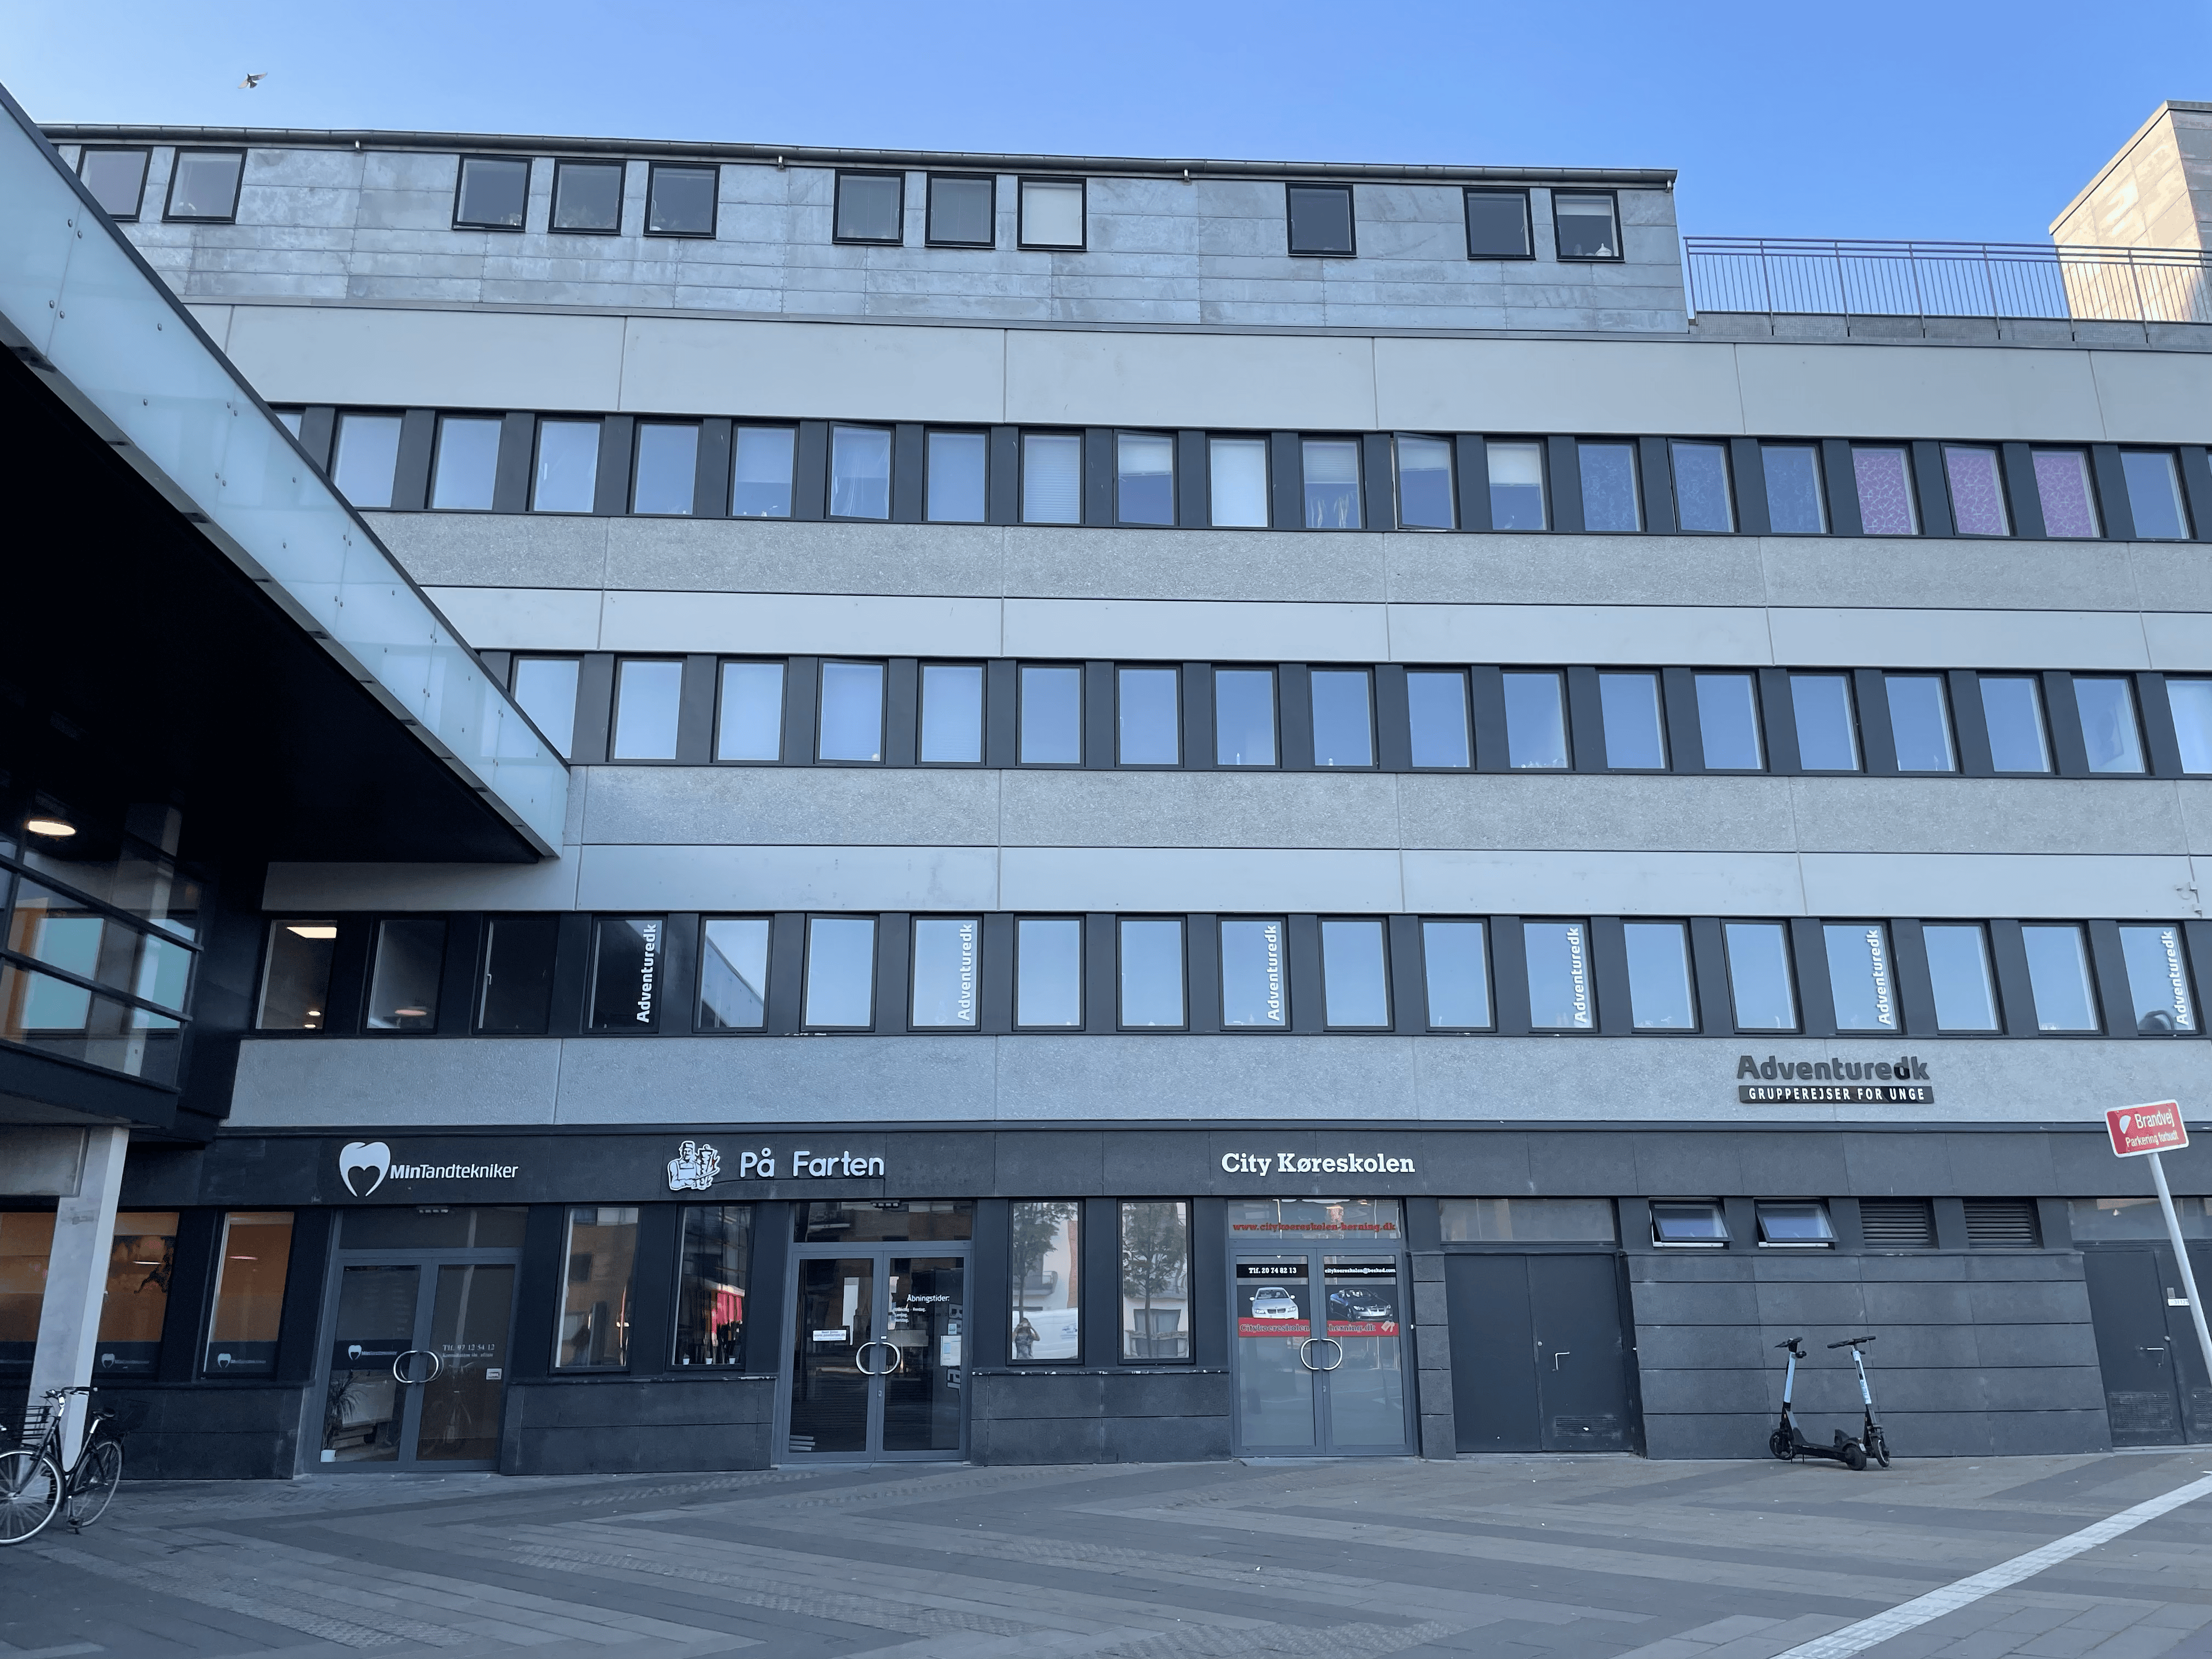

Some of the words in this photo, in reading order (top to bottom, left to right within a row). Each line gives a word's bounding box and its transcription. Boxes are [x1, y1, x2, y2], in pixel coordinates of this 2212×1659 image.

[636, 924, 656, 1023] Adventuredk
[958, 924, 972, 1021] Adventuredk
[1264, 925, 1280, 1021] Adventuredk
[1567, 927, 1587, 1023] Adventuredk
[1866, 930, 1891, 1025] Adventuredk
[2161, 930, 2188, 1025] Adventuredk
[1737, 1055, 1930, 1080] Adventuredk
[1749, 1088, 1850, 1101] GRUPPEREJSER
[1858, 1088, 1883, 1100] FOR
[1889, 1088, 1925, 1100] UNGE
[2134, 1108, 2175, 1129] Brandvej
[2125, 1133, 2159, 1148] Parkering
[2158, 1130, 2179, 1143] forbudt
[390, 1164, 518, 1179] MinTandtekniker
[740, 1147, 775, 1178] På
[793, 1150, 884, 1176] Farten
[1221, 1153, 1272, 1176] City
[1277, 1153, 1416, 1173] Køreskolen
[1233, 1222, 1396, 1232] www.citykoereskolen-herning.dk
